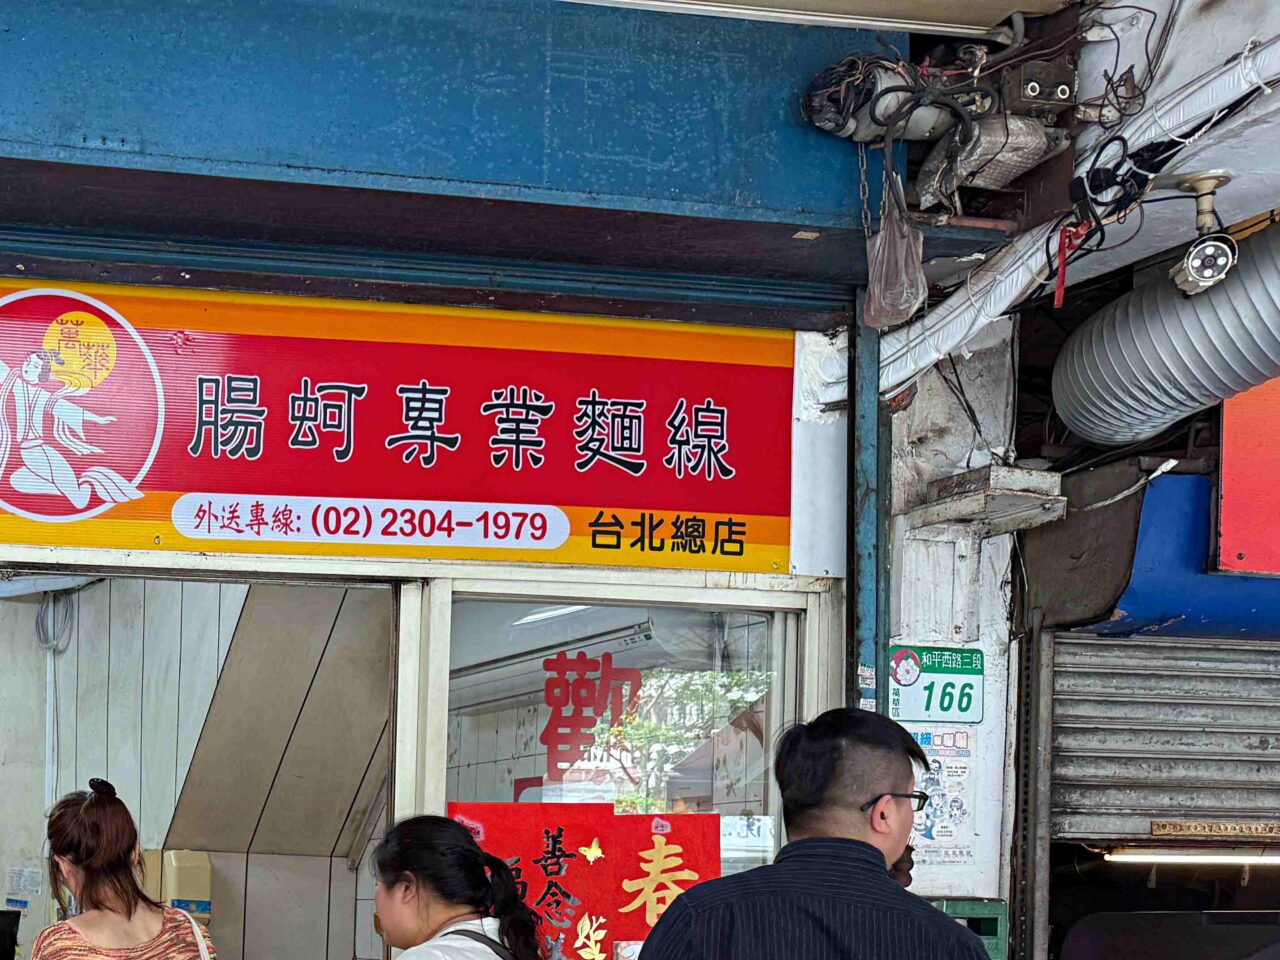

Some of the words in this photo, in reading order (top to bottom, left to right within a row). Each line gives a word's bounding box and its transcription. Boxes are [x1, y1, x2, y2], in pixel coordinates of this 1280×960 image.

[187, 374, 736, 481] 腸蚵專業麵線
[193, 500, 302, 536] 外送專線:
[588, 510, 747, 557] 台北總店
[921, 651, 982, 670] 和平西路三段
[923, 681, 974, 713] 166
[618, 834, 700, 928] 春
